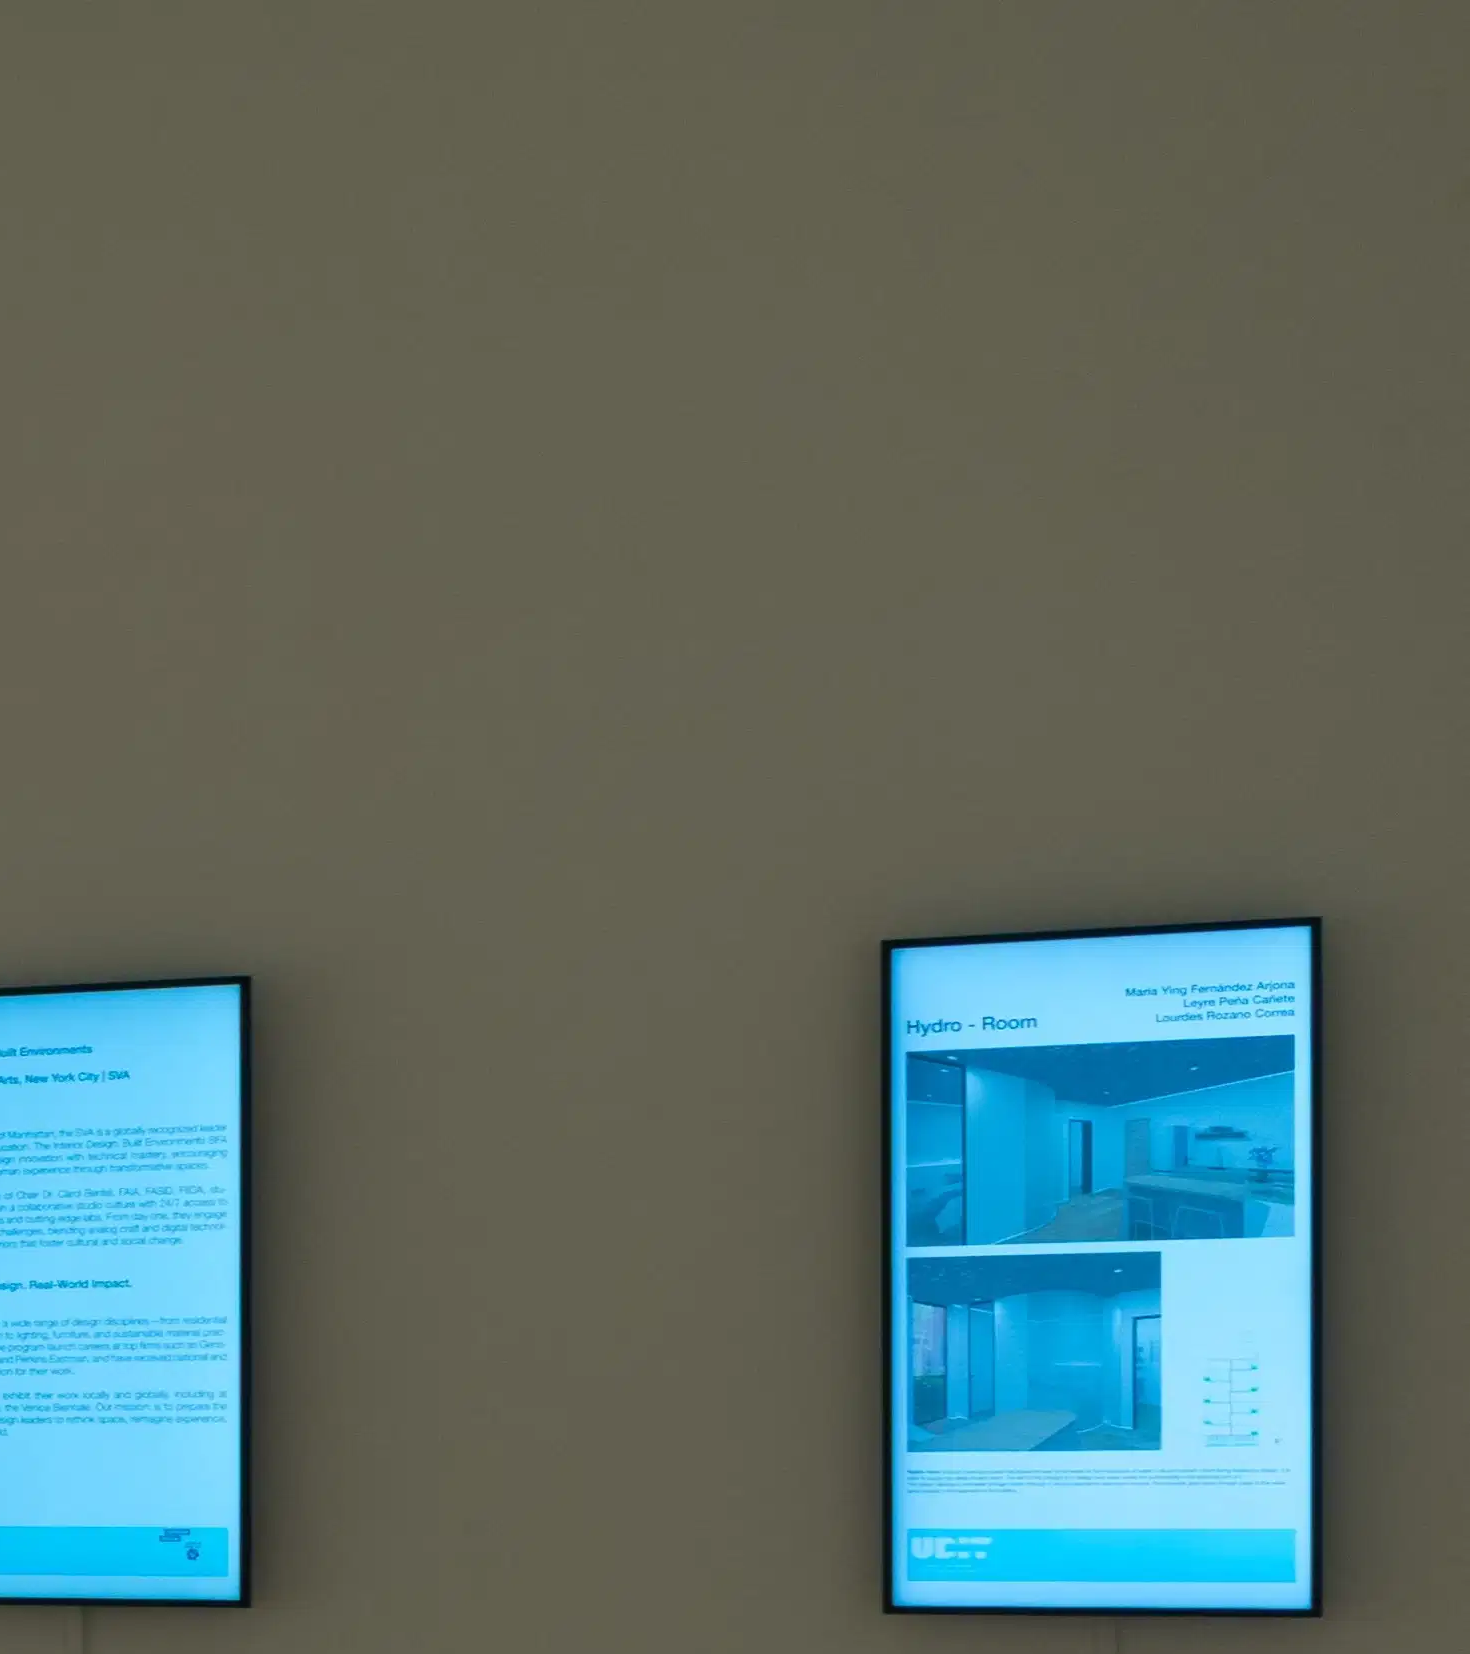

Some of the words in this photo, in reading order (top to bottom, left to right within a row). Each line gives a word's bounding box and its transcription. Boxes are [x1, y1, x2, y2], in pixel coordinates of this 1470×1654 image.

[1161, 985, 1188, 997] Ying
[1256, 980, 1295, 993] Arjona
[906, 1019, 962, 1037] Hydro
[982, 1016, 1038, 1031] Room
[20, 1045, 93, 1057] Environments
[25, 1074, 49, 1084] New
[51, 1073, 76, 1083] York
[78, 1072, 100, 1084] City
[108, 1071, 131, 1081] SVA
[92, 1279, 132, 1291] Impact.
